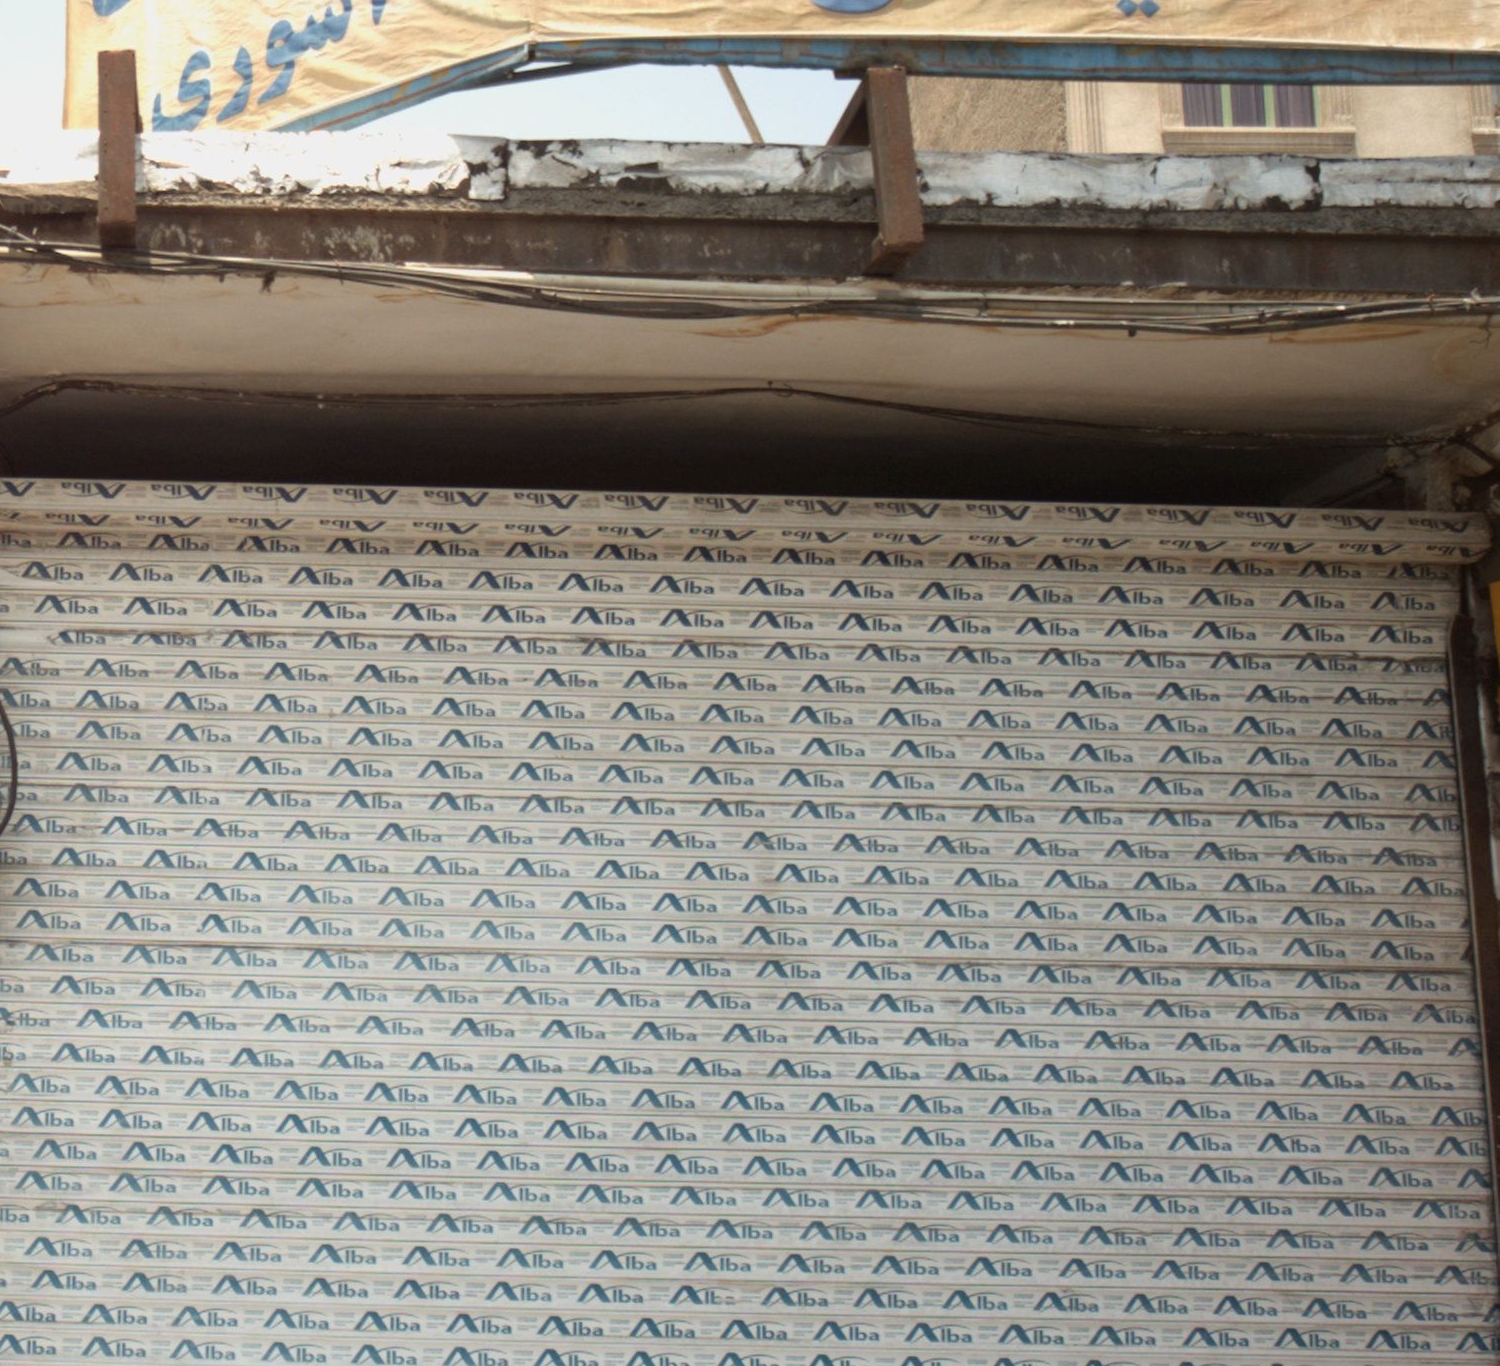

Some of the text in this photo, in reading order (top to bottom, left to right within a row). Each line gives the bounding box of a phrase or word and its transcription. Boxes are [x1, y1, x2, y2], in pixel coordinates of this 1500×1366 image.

[20, 560, 1435, 611] Alba Alba Alba Alba Alba Alba Alba Alba Alba Alba Alba Alba Alba Alba Alba Alba
[74, 690, 1383, 738] Alba Alba Alba Alba Alba Alba Alba Alba Alba Alba Alba Alba Alba Alba
[16, 910, 1434, 961] Alba Alba Alba Alba Alba Alba Alba Alba Alba Alba Alba Alba Alba Alba Alba Alba
[11, 1107, 1409, 1155] Alba Alba Alba Alba Alba Alba Alba Alba Alba Alba Alba Alba Alba Alba Alba Alba
[32, 1270, 1457, 1321] Alba Alba Alba Alba Alba Alba Alba Alba Alba Alba Alba Alba Alba Alba Alba
